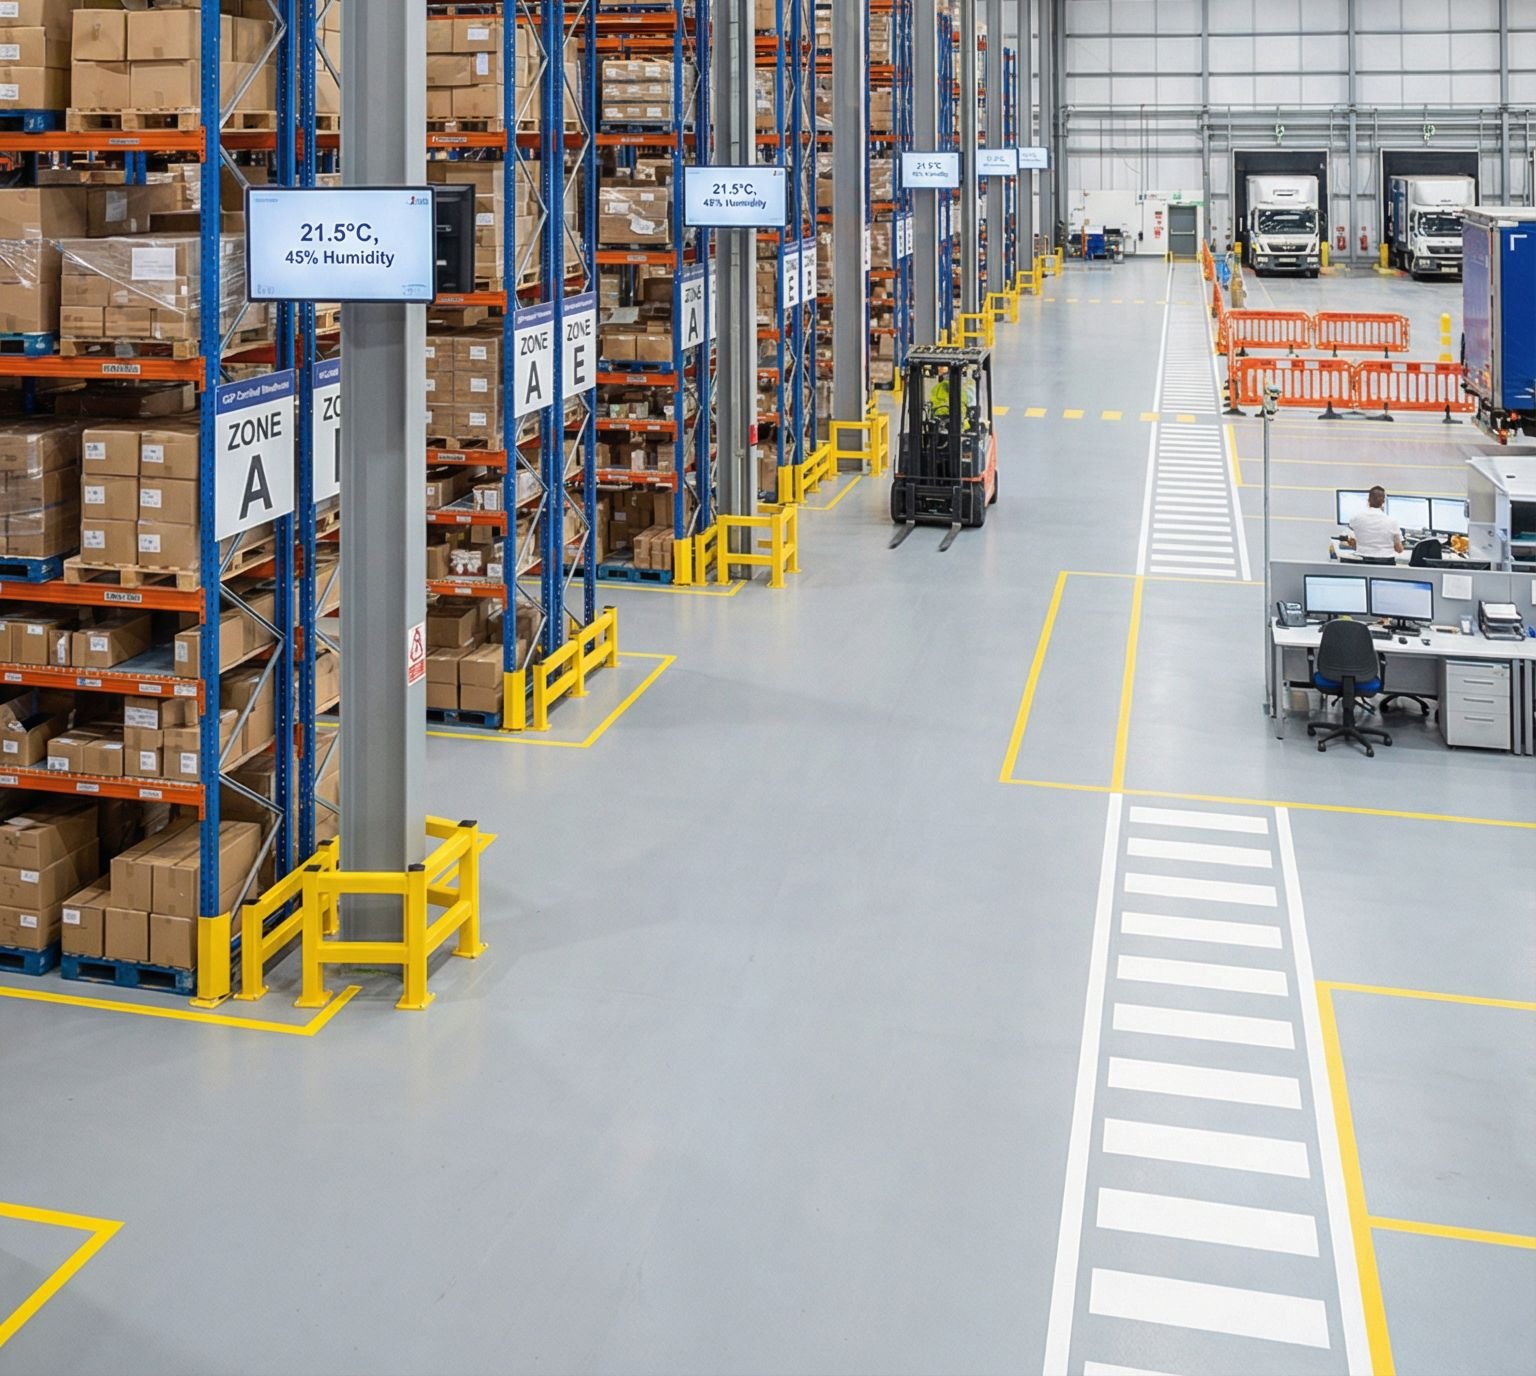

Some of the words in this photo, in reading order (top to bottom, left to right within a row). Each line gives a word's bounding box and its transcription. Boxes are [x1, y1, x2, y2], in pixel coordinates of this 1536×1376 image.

[300, 223, 379, 246] 21.5°C,
[285, 250, 319, 265] 45%
[323, 250, 395, 268] Humidity
[566, 318, 591, 342] ZONE
[688, 307, 698, 342] A
[520, 331, 548, 356] ZONE
[525, 360, 542, 404] A
[574, 345, 585, 386] E
[227, 411, 282, 451] ZONE
[238, 454, 273, 520] A
